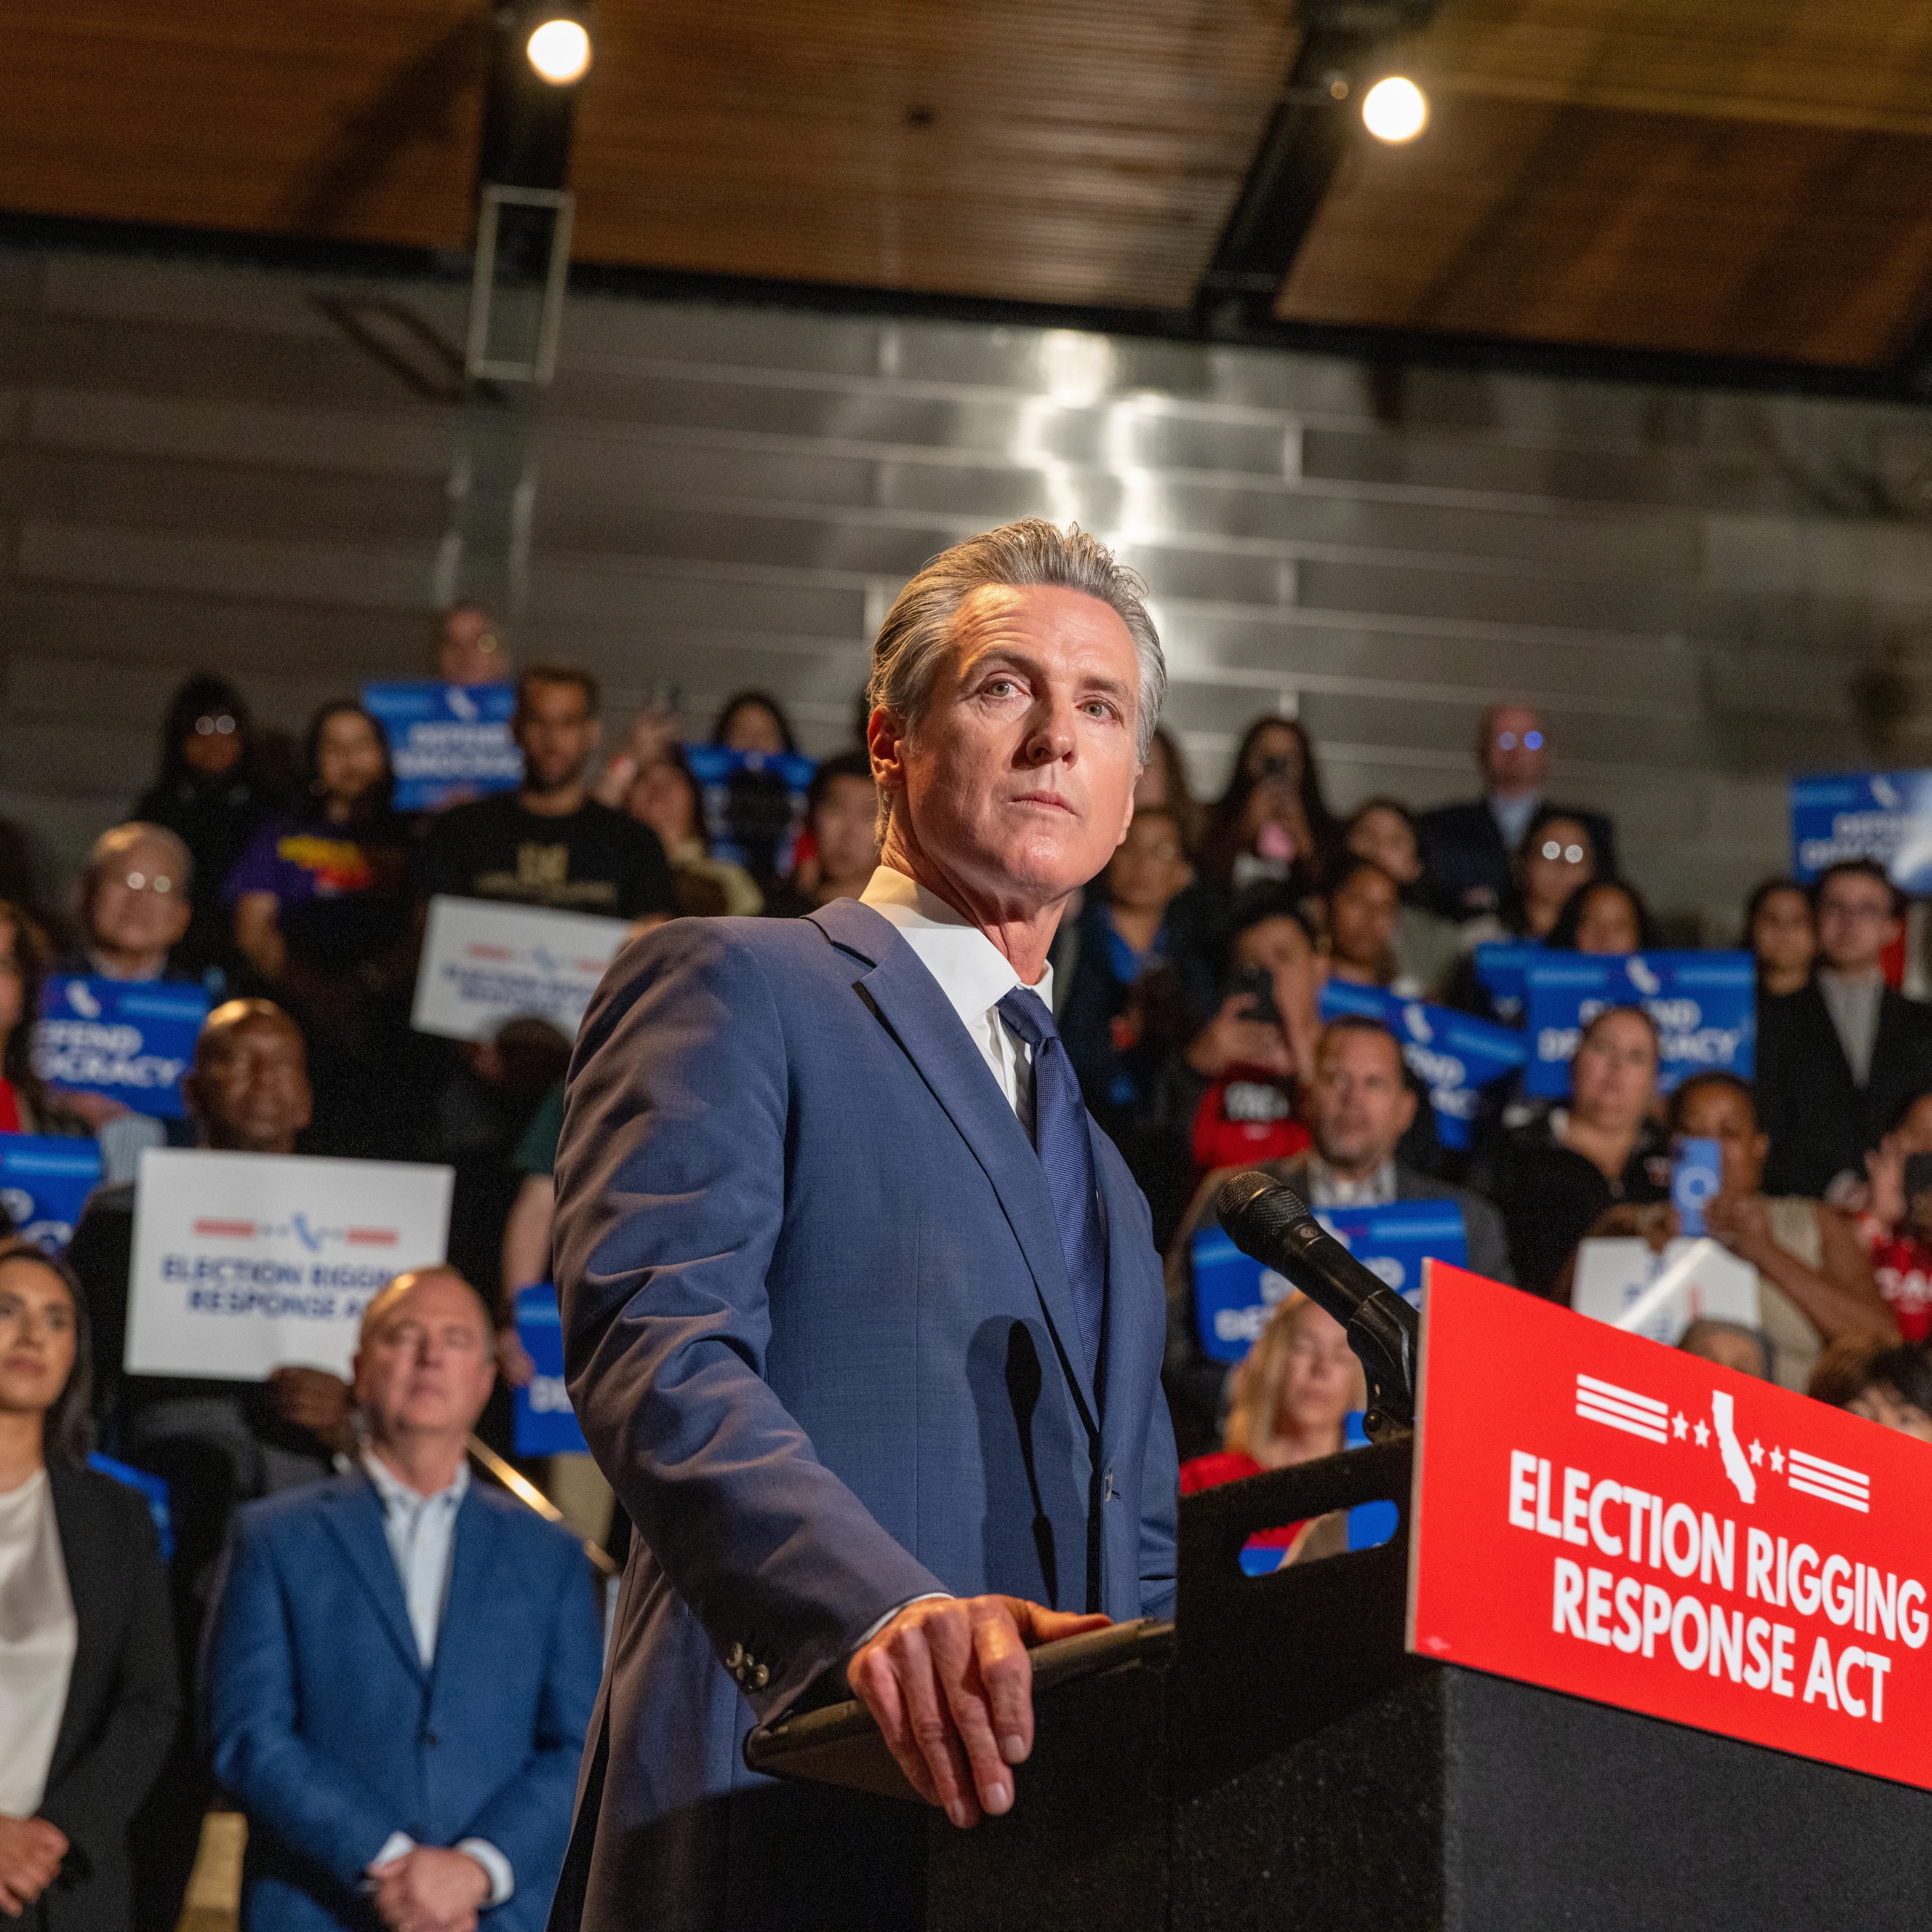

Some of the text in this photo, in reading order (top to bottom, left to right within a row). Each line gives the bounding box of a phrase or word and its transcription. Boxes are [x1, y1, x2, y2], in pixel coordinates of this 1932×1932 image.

[162, 1254, 303, 1286] ELECTION
[189, 1289, 335, 1319] RESPONSE
[1509, 1450, 1929, 1649] ELECTION RIGGING
[1553, 1558, 1891, 1723] RESPONSE ACT
